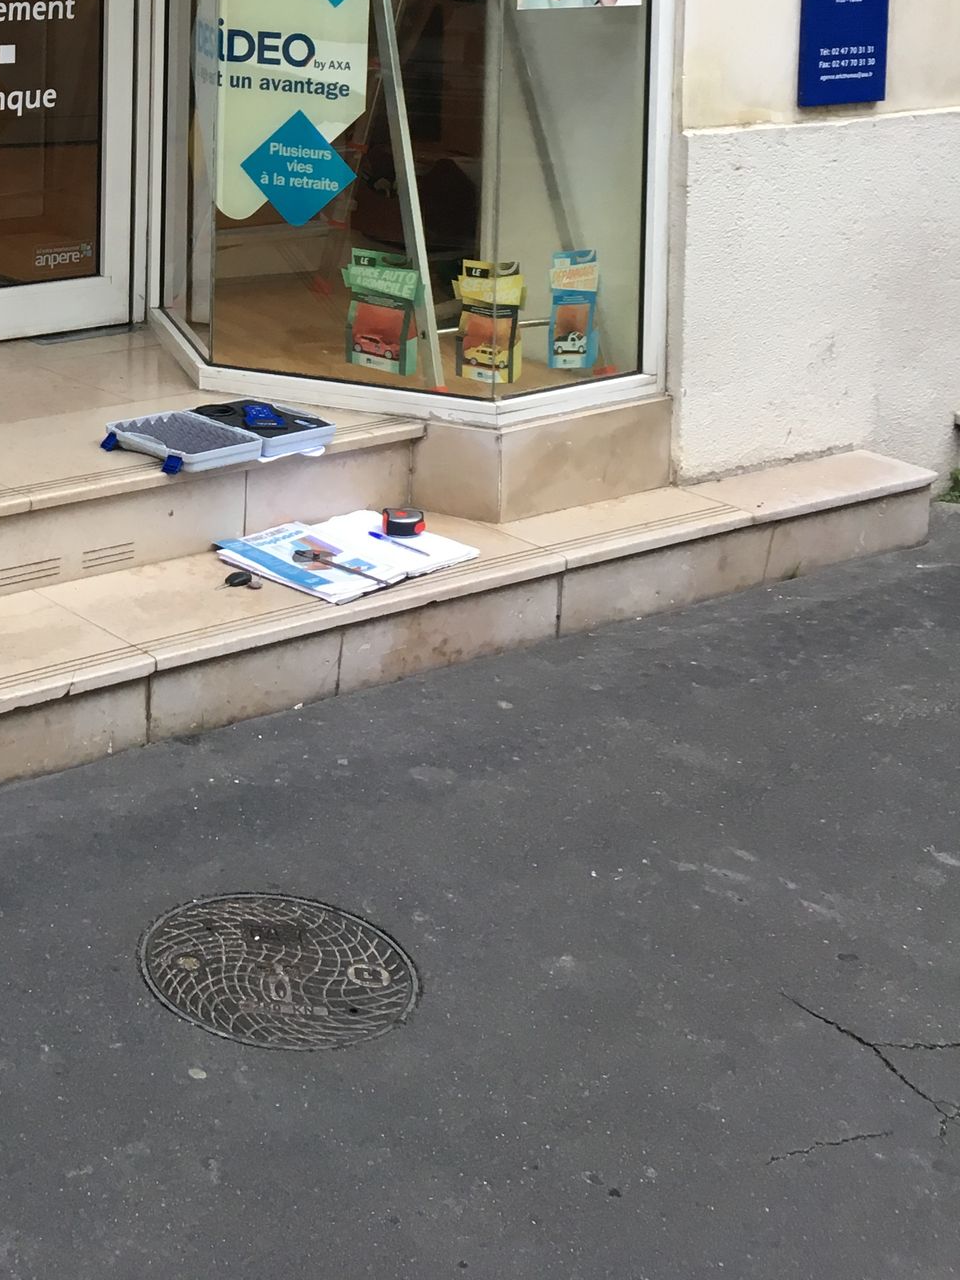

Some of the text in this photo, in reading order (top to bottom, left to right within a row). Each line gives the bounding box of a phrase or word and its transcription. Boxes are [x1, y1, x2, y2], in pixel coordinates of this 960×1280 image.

[831, 47, 840, 55] 02
[840, 47, 849, 55] 47
[849, 46, 858, 54] 70
[313, 59, 327, 71] by
[328, 60, 351, 71] AXA
[831, 60, 840, 68] 02
[840, 59, 849, 67] 47
[849, 59, 858, 67] 70
[229, 73, 252, 90] un
[258, 76, 350, 100] avantage
[269, 142, 332, 161] Plusieurs
[286, 161, 314, 174] vies
[260, 172, 339, 191] à la retraite
[35, 251, 80, 269] anpere
[360, 256, 369, 266] LE
[381, 270, 416, 284] AUTO
